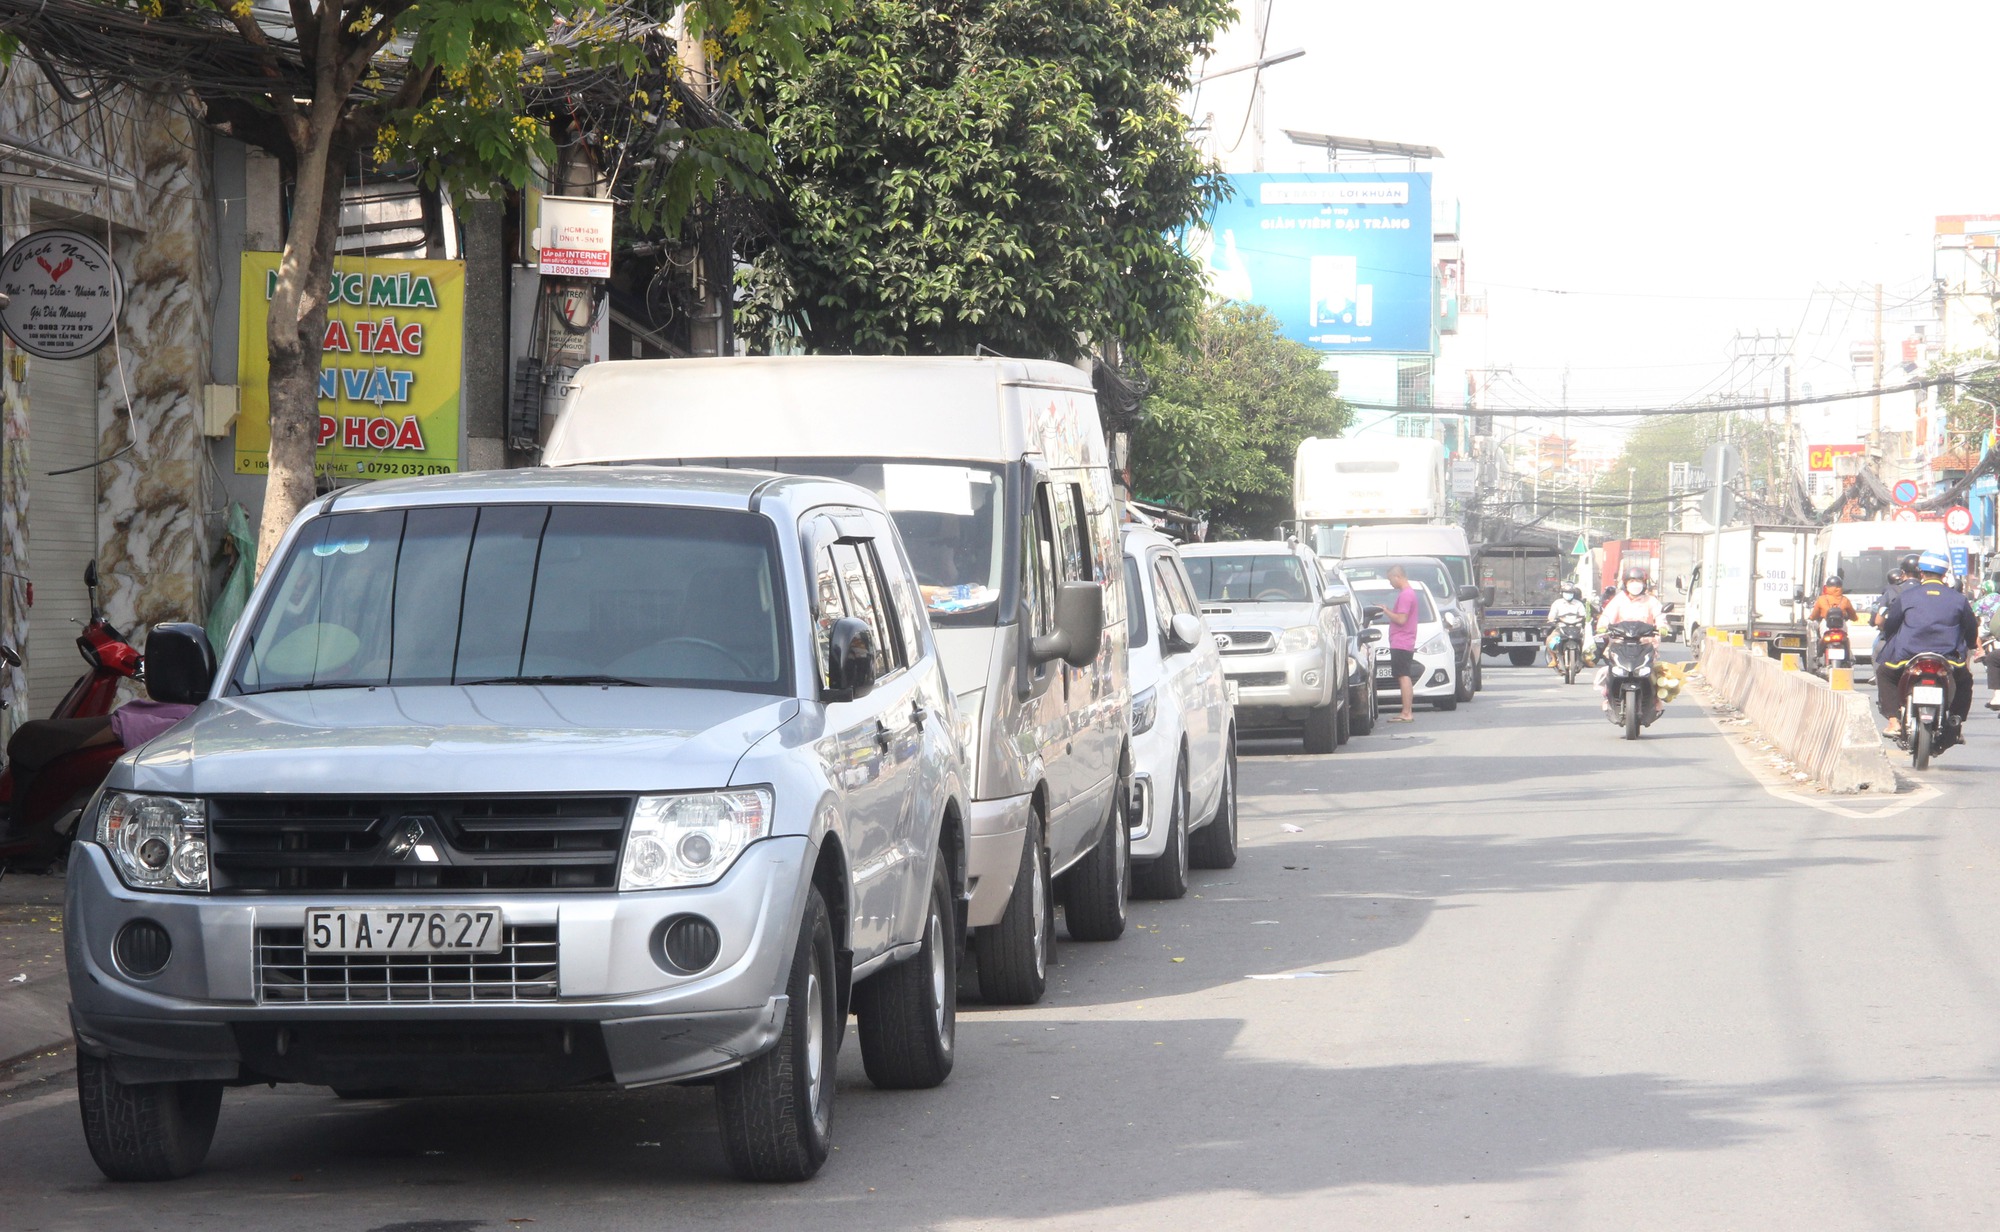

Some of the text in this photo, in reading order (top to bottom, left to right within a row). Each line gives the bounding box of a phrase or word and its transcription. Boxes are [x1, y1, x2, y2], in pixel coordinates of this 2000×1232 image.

[566, 250, 608, 261] INTERNET
[551, 266, 590, 276] 18008168
[368, 272, 437, 307] MÍA
[59, 306, 87, 321] Massage
[354, 317, 423, 355] TẮC
[343, 415, 426, 450] HOÁ
[368, 463, 398, 474] 0792
[402, 464, 424, 476] 032
[1763, 582, 1789, 592] 193.23
[313, 911, 495, 949] 51A-776.27
